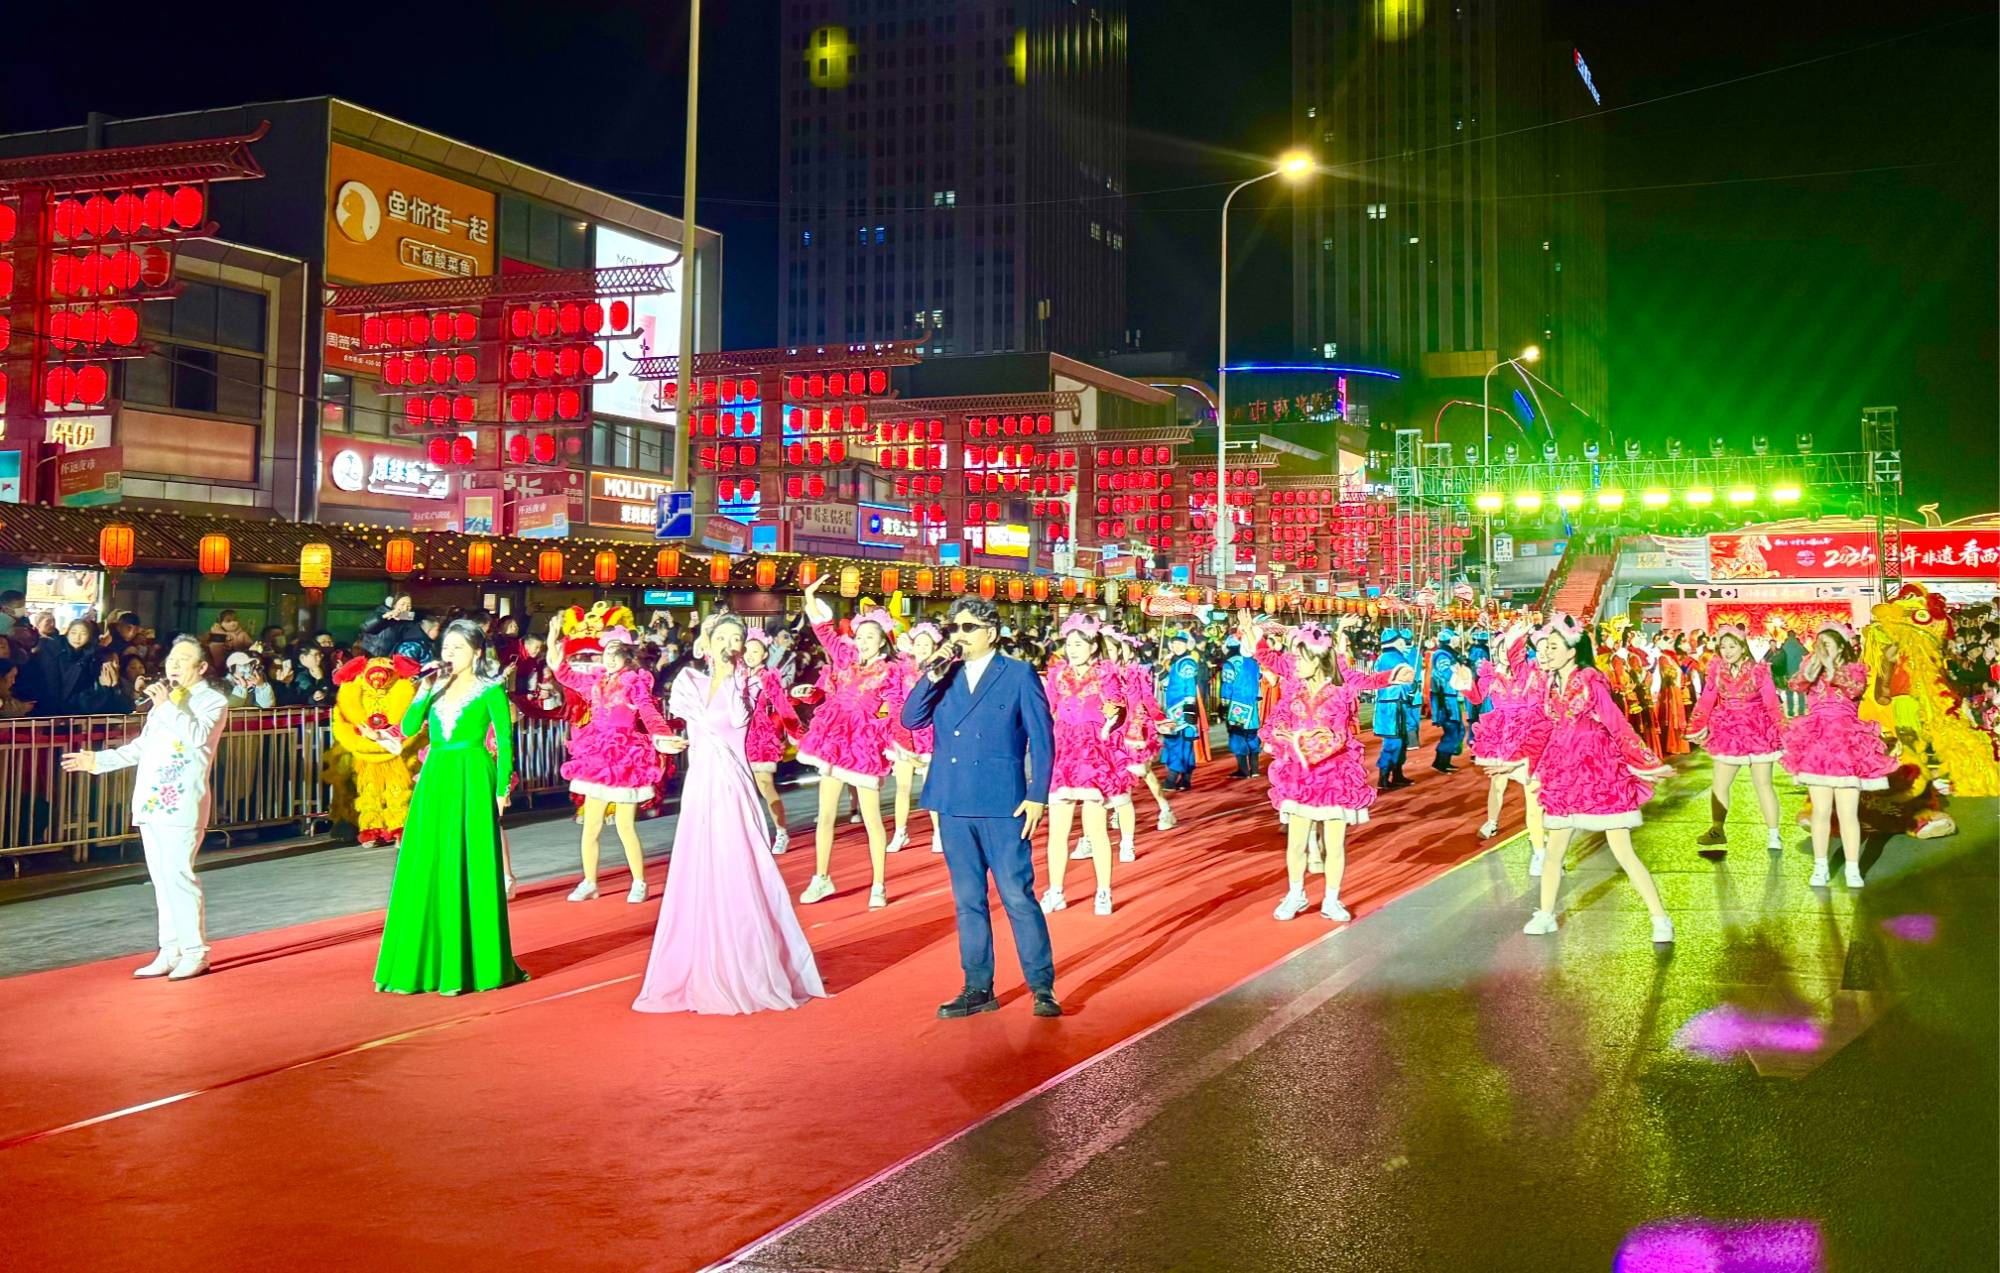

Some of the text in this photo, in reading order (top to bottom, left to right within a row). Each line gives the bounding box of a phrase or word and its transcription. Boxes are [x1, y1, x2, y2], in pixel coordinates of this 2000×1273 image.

[388, 189, 489, 245] 鱼你在一起
[409, 244, 472, 277] 下饭酸菜鱼
[1822, 545, 1877, 569] 2026
